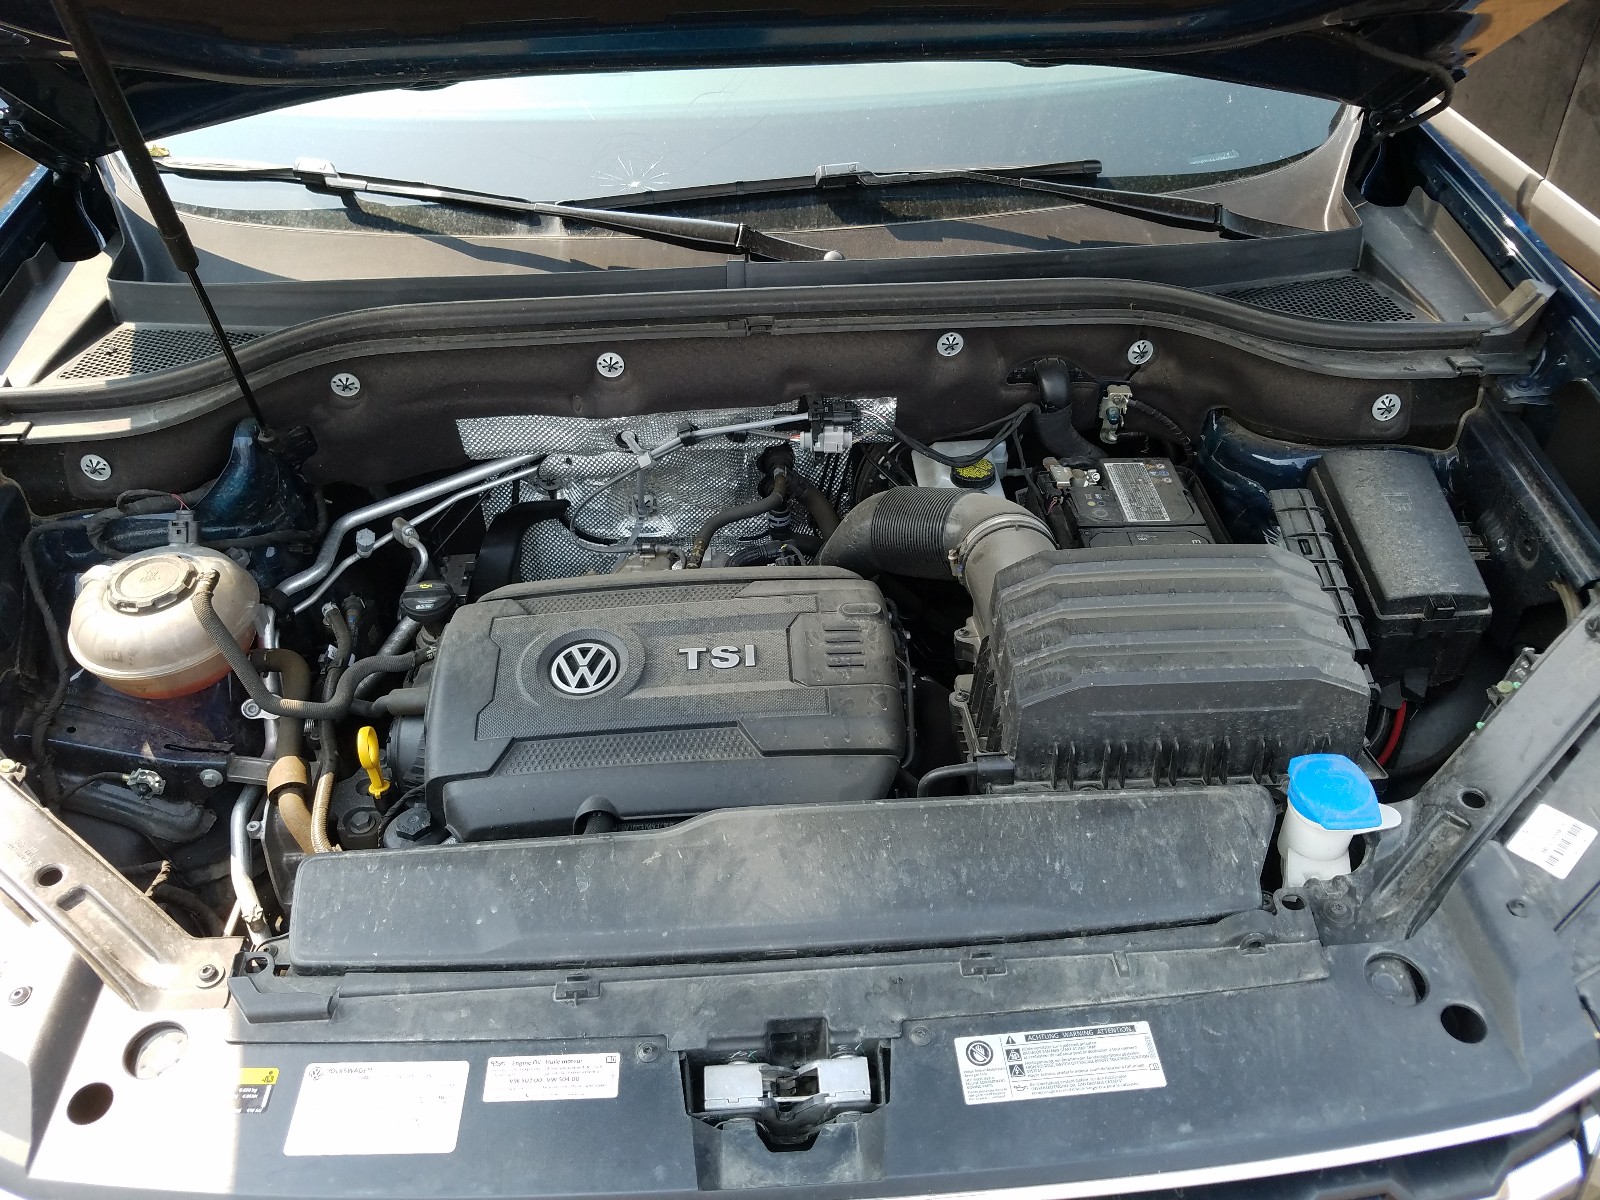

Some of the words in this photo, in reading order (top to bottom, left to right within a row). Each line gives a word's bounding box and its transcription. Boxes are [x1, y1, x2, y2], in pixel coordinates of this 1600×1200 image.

[551, 642, 617, 694] VW
[679, 644, 756, 670] TSI
[1027, 1032, 1059, 1042] ACHTUNG
[1062, 1029, 1094, 1038] WARNING
[1097, 1026, 1132, 1036] ATTENTION
